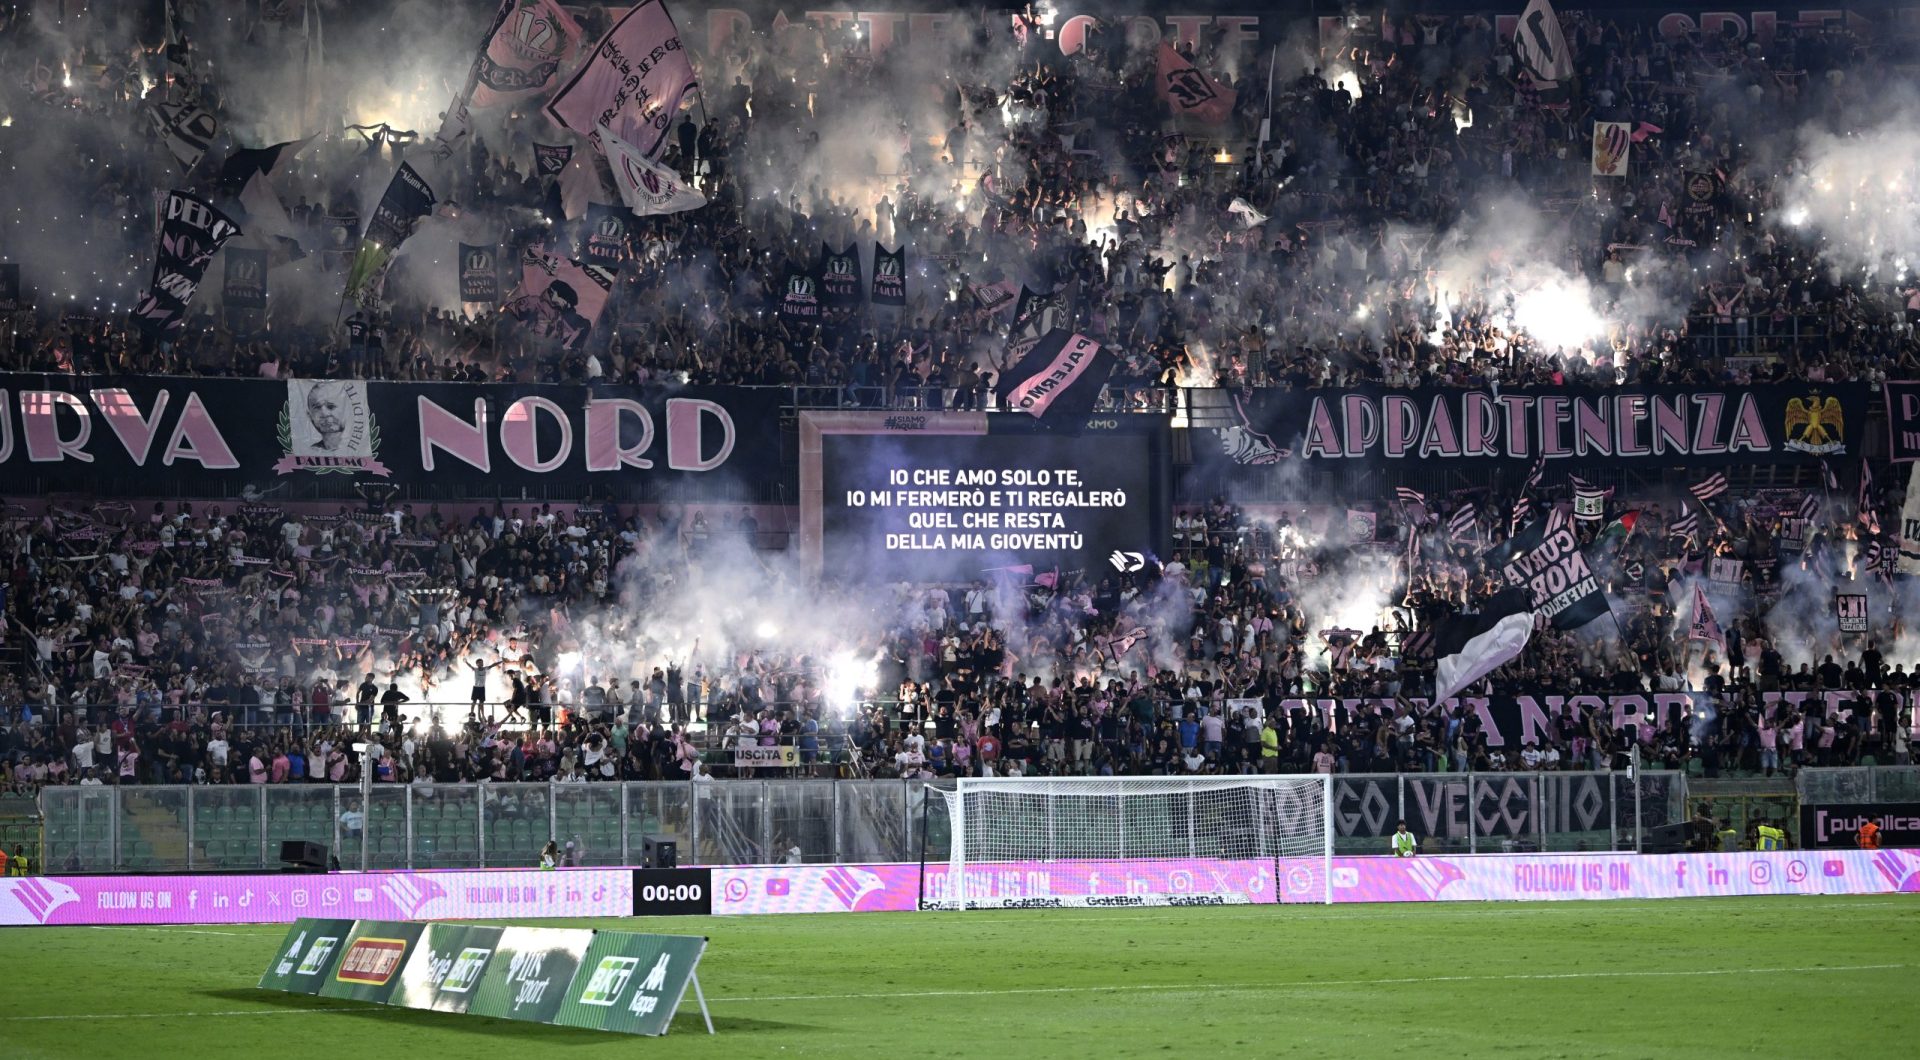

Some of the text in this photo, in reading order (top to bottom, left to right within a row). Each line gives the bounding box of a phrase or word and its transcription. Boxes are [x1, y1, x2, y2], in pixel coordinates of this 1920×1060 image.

[515, 10, 553, 53] 12
[352, 402, 363, 416] DI
[0, 388, 736, 474] RVA NORD
[1087, 420, 1118, 430] RMO
[1302, 391, 1772, 460] APPARTENENZA
[347, 421, 364, 451] FIERI
[295, 456, 368, 468] PALERMO
[890, 469, 1083, 488] IO CHE AMO SOLO TE,
[847, 487, 1126, 507] IO MI FERMERÒ E TI REGALERÒ
[909, 512, 1066, 530] QUEL CHE RESTA
[886, 530, 1083, 550] DELLA MIA GIOVENTÙ
[1838, 596, 1866, 617] CNI
[736, 750, 794, 762] USCITA 9
[927, 872, 993, 898] FOOW
[1515, 864, 1576, 892] FOLLOW
[1582, 863, 1603, 892] US
[1609, 862, 1630, 891] ON
[98, 891, 137, 909] FOLLOW
[141, 890, 154, 908] US
[157, 889, 171, 908] ON
[466, 887, 503, 904] FOLLOW
[507, 887, 520, 903] US
[523, 886, 536, 902] ON
[643, 885, 701, 901] 00:00
[1087, 896, 1145, 906] GoldBet
[453, 958, 485, 983] BKT
[588, 968, 631, 994] BKT
[513, 977, 550, 1011] sport
[628, 990, 658, 1017] Kappa
